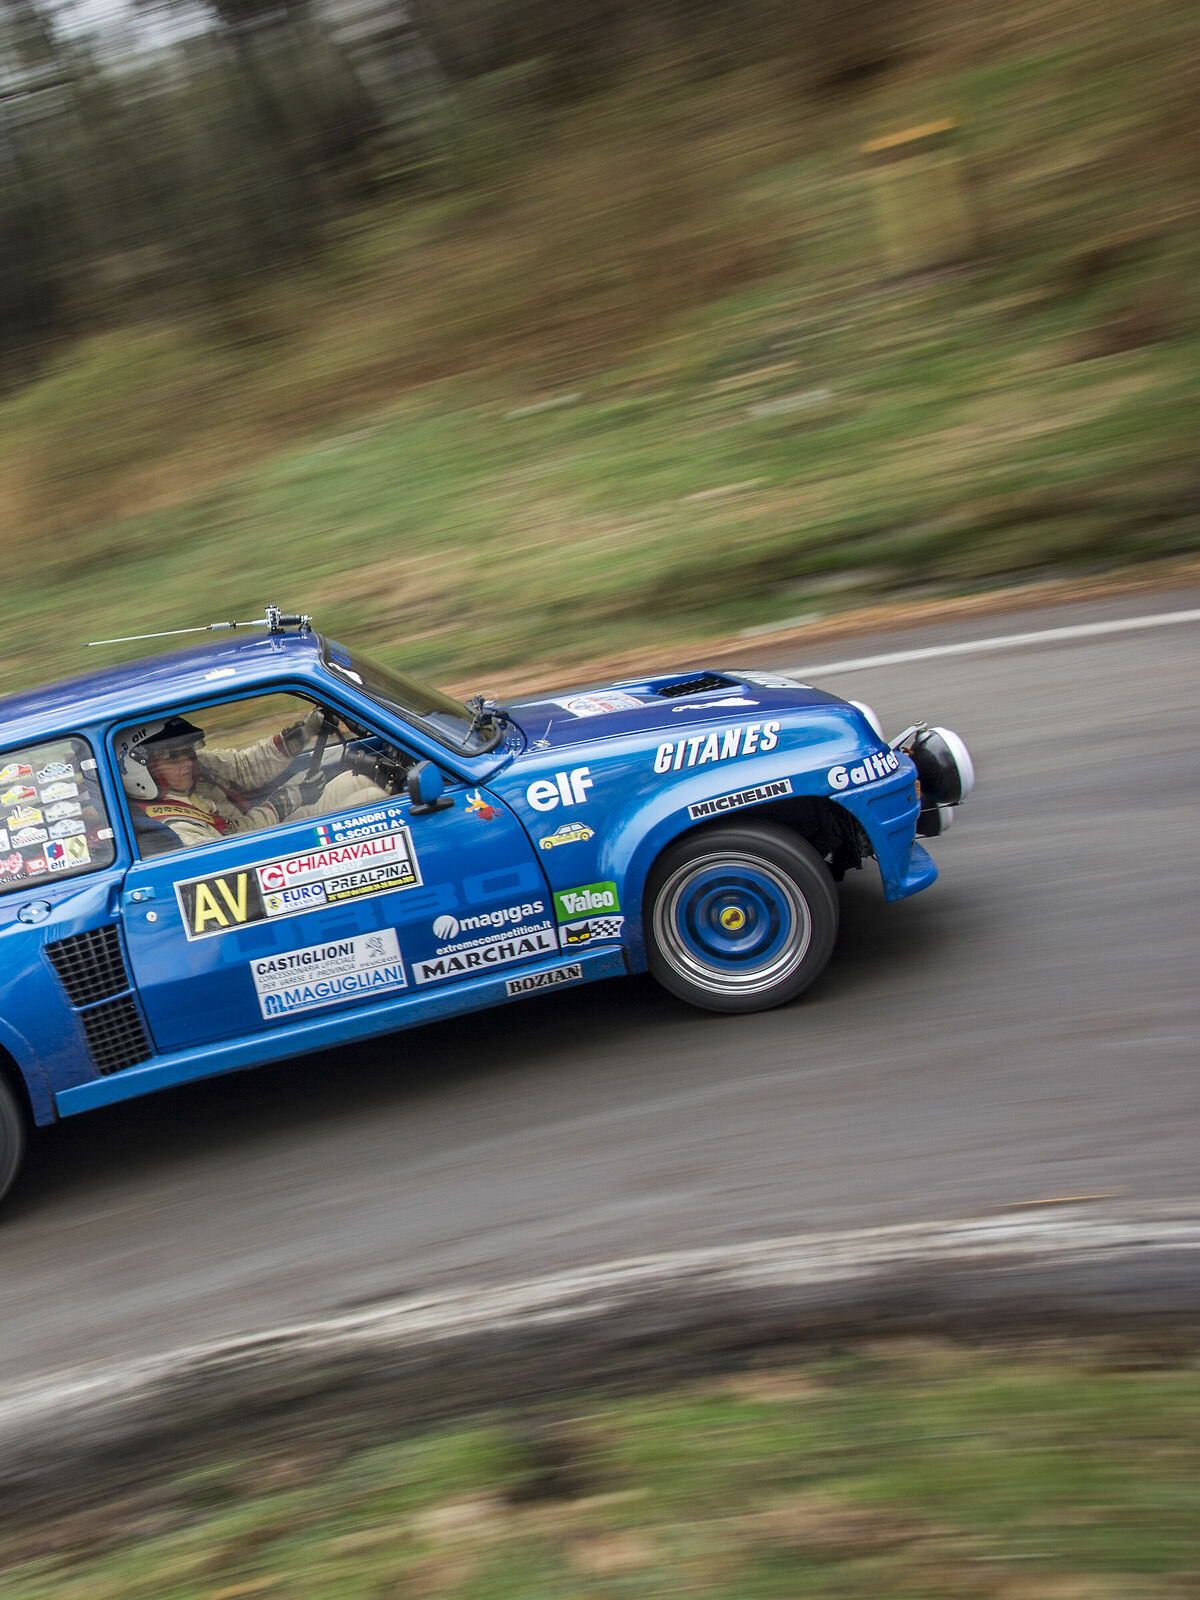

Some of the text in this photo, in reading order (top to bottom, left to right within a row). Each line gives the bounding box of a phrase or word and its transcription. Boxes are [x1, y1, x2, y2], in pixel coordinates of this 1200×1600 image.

[132, 728, 147, 743] elf
[653, 721, 781, 774] GITANES
[827, 750, 900, 790] Galtier
[527, 766, 594, 812] elf
[691, 781, 788, 818] MICHELIN
[331, 811, 386, 832] M.SANDRI
[334, 818, 406, 842] G.SCOTTI A+
[51, 860, 66, 870] elf
[286, 837, 396, 875] CHIARAVALLI
[283, 884, 323, 903] EURO
[330, 864, 409, 891] PREALPINA
[195, 873, 248, 933] AV
[460, 900, 545, 932] magigas
[560, 889, 615, 914] Valeo
[436, 920, 552, 955] extremecompetition.it
[257, 942, 354, 975] CASTIGLIONI
[422, 935, 550, 979] MARCHAL
[285, 964, 404, 1005] MAGUGLIANI
[508, 965, 580, 995] BOZIAN
